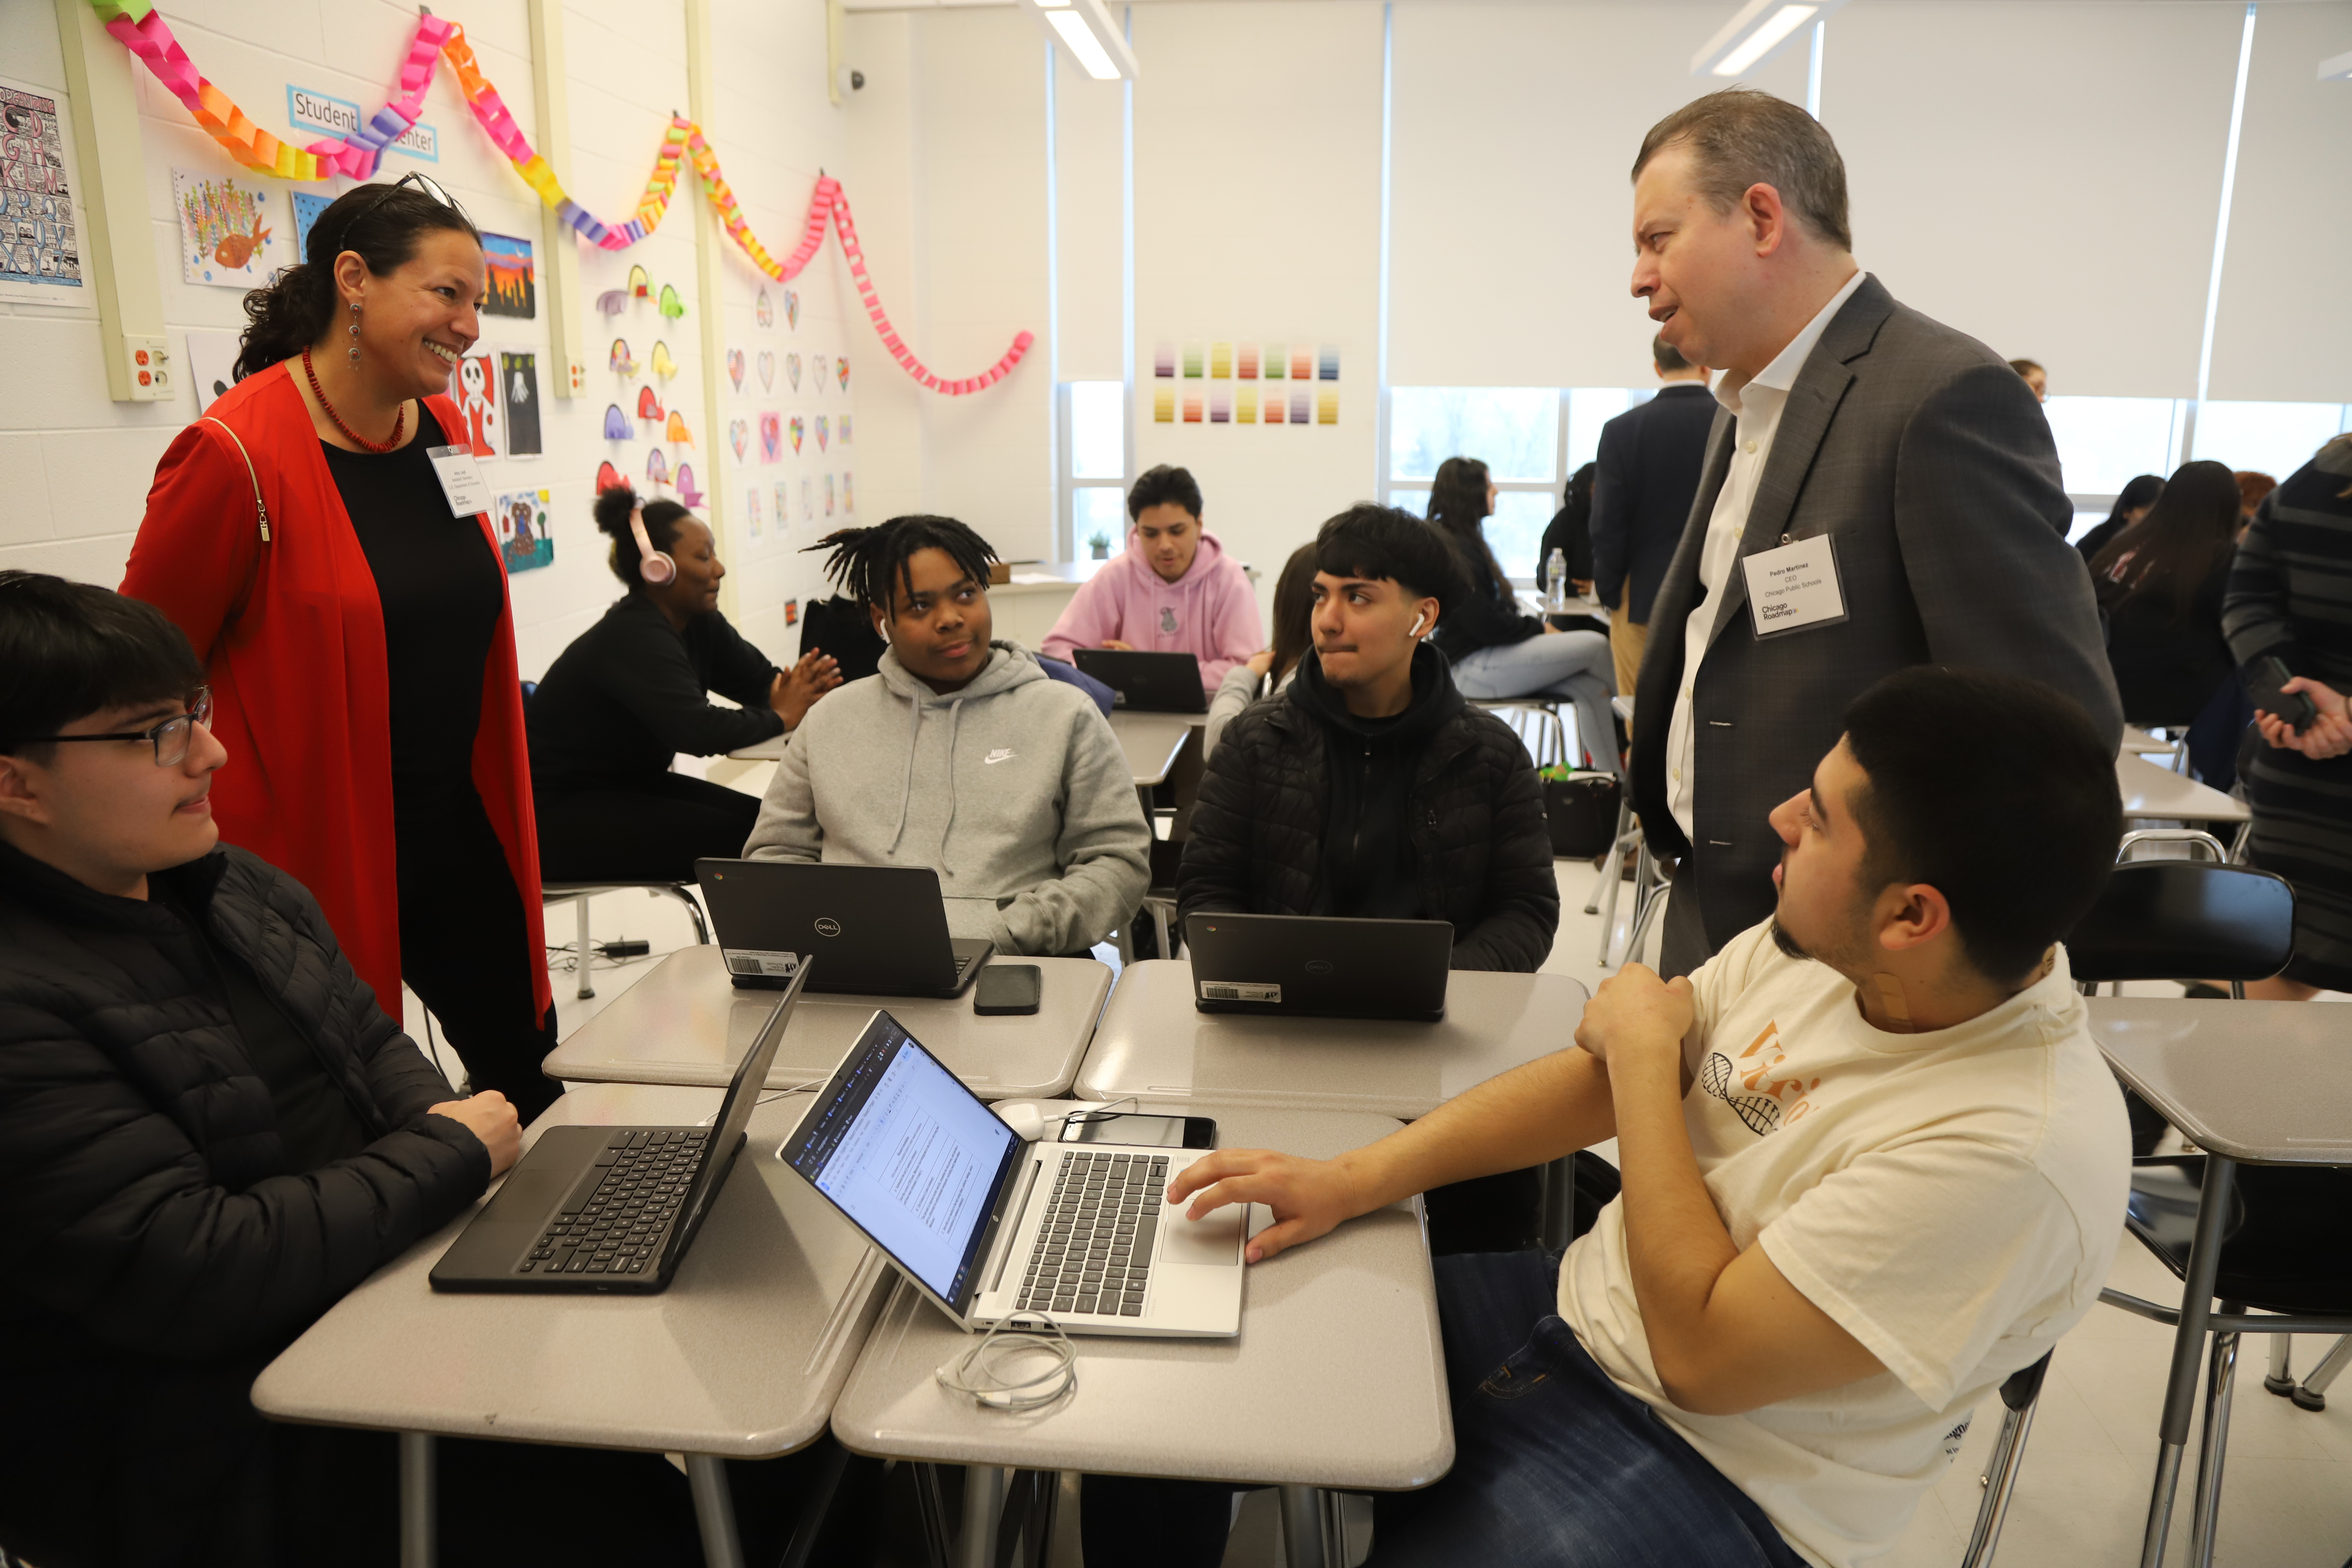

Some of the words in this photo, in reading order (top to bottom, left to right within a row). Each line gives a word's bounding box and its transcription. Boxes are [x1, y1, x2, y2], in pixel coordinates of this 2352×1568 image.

[28, 110, 43, 138] D
[296, 93, 357, 131] Student
[3, 134, 20, 161] G
[28, 139, 47, 166] H
[0, 159, 18, 189] K
[23, 164, 37, 191] L
[43, 167, 58, 195] M
[17, 189, 31, 217] P
[42, 195, 56, 222] Q
[33, 220, 46, 249] U
[52, 225, 65, 250] V
[0, 243, 23, 273] X
[27, 247, 44, 275] Y
[54, 250, 65, 277] Z
[1786, 563, 1808, 573] Martinez
[1765, 589, 1785, 597] Chicago
[1786, 584, 1801, 592] Public
[1802, 579, 1822, 588] Schools
[1762, 602, 1787, 613] Chicago
[1764, 608, 1793, 620] Roadmap
[990, 748, 1011, 758] NIKE
